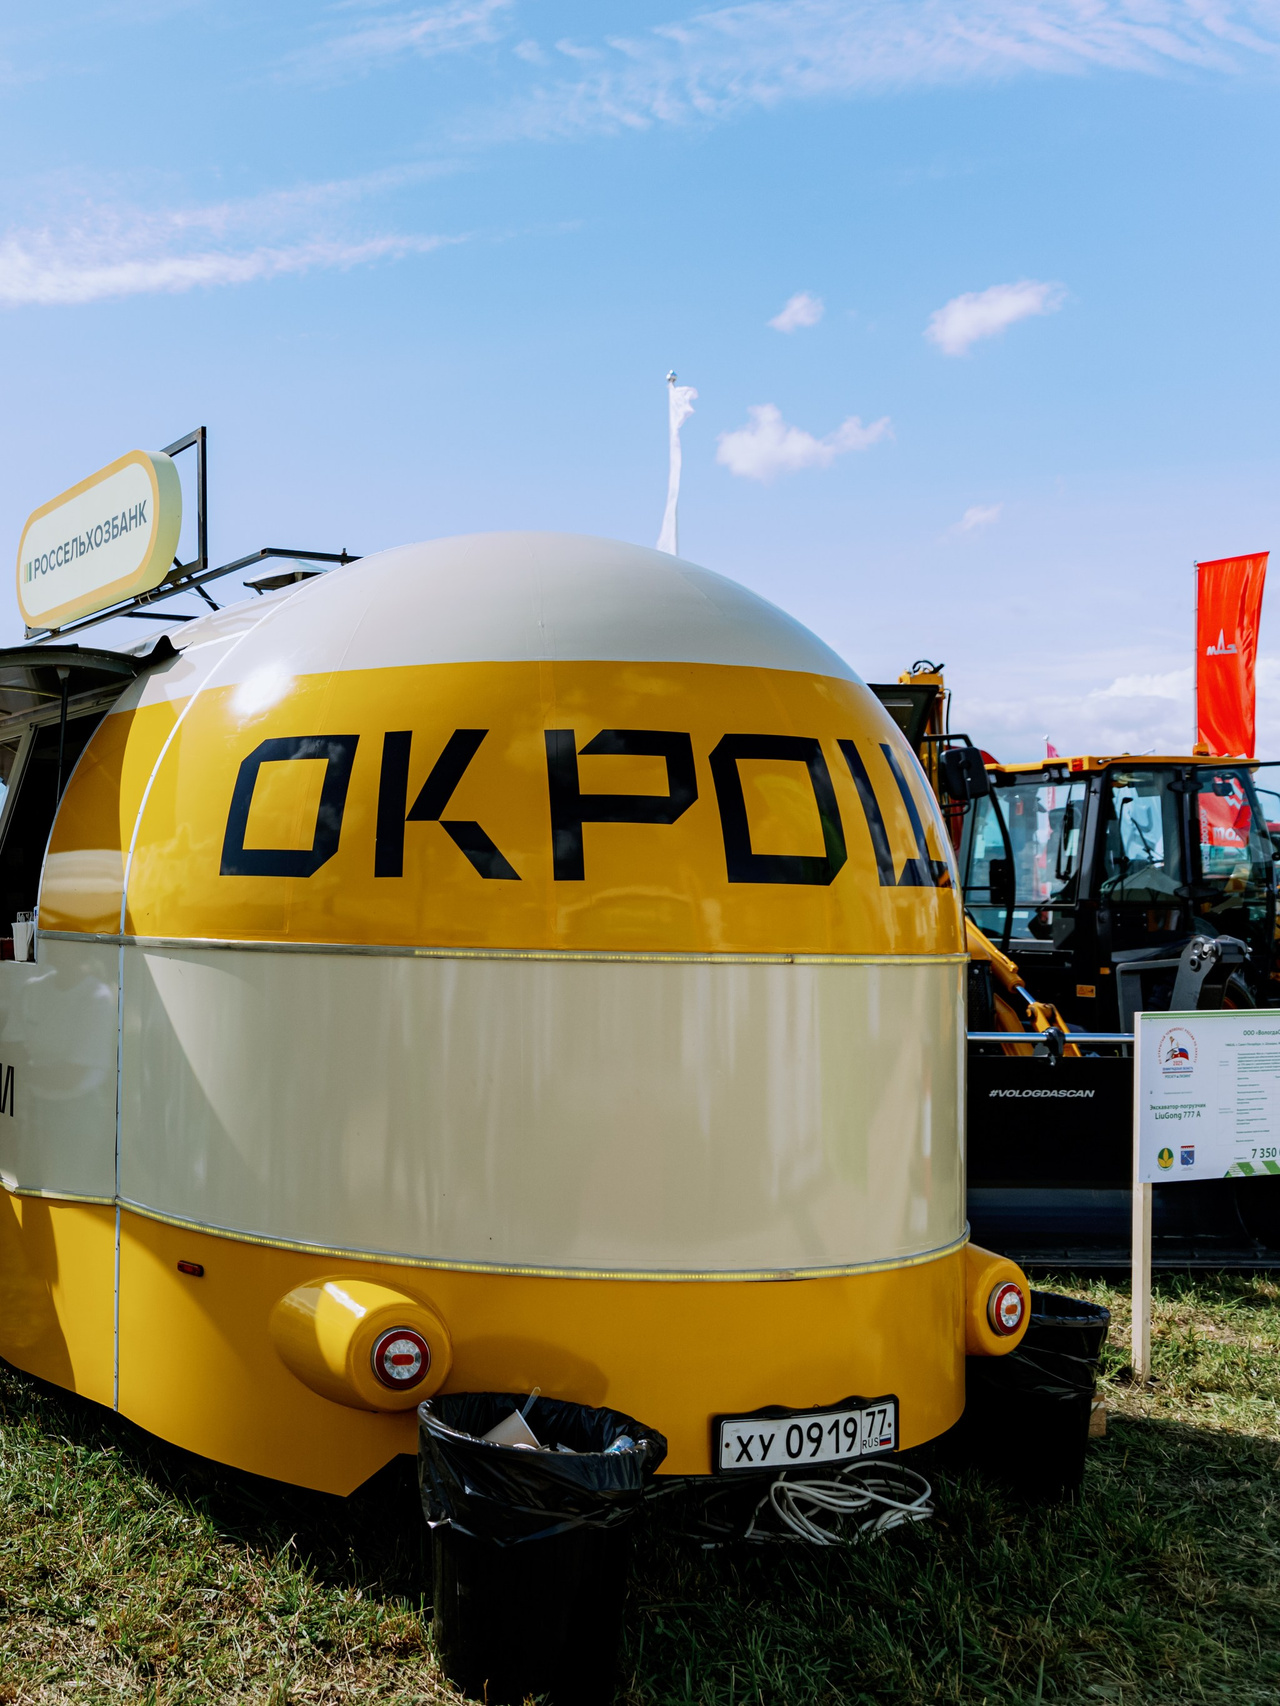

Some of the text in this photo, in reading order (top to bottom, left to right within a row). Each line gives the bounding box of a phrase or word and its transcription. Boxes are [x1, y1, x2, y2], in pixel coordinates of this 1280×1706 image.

[34, 499, 148, 579] РОССЕЛЬХОЗБАНК
[988, 1089, 1095, 1098] #VOLOGDASCAN
[1149, 1103, 1206, 1111] Экскаватор-погрузчик
[1154, 1111, 1183, 1121] LiuGong
[1183, 1110, 1195, 1119] 777
[785, 1417, 858, 1459] 0919
[865, 1408, 888, 1438] 77
[862, 1436, 879, 1449] RUS
